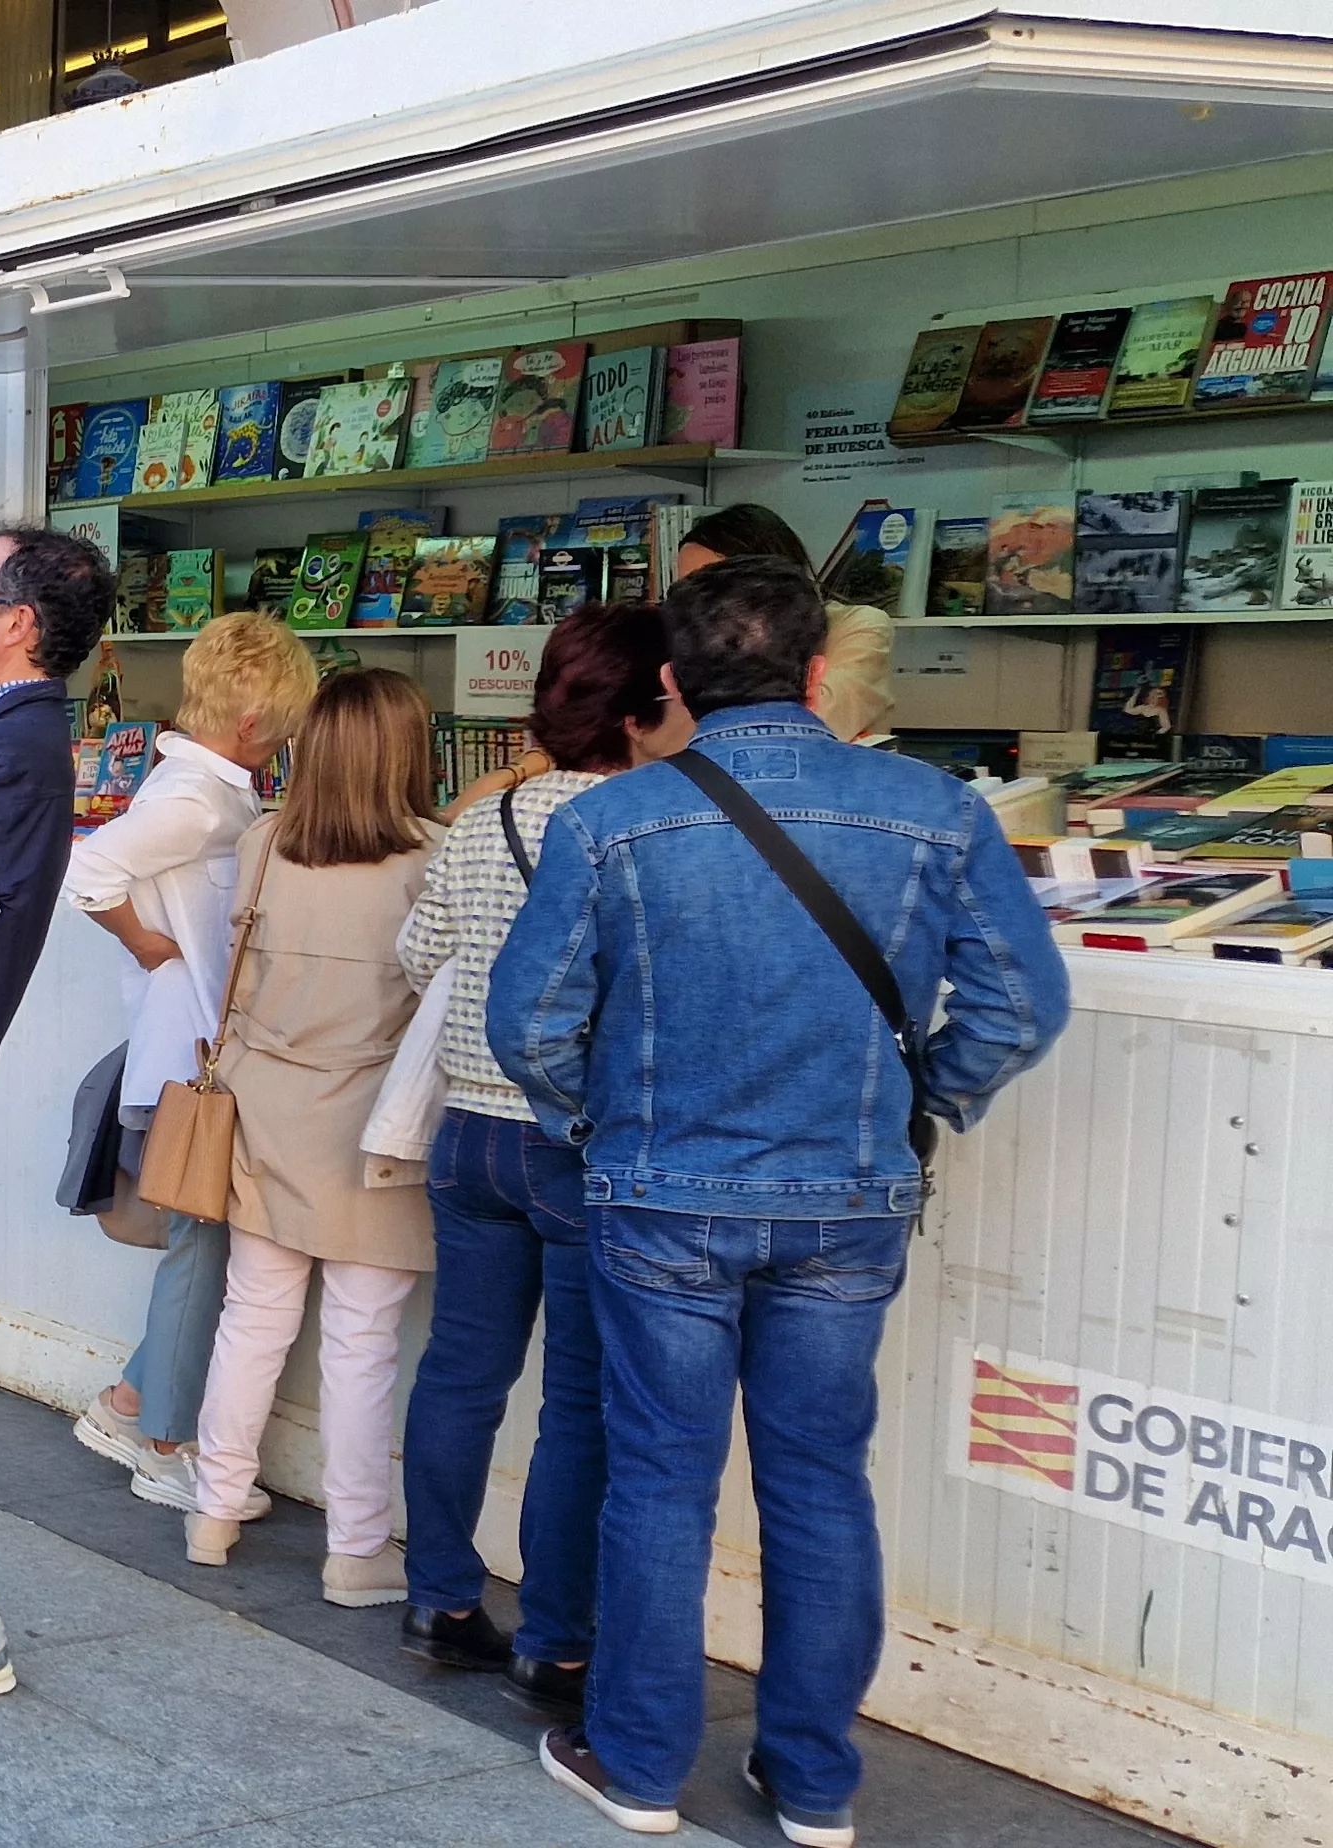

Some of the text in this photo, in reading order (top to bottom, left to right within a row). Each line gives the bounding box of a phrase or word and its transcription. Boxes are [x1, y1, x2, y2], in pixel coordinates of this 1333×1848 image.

[1253, 277, 1326, 311] COCINA
[1284, 305, 1320, 345] 10
[585, 361, 629, 401] TODO
[805, 426, 849, 439] FERIA
[852, 422, 883, 435] DEL
[805, 439, 885, 455] DE HUESCA
[1299, 498, 1312, 513] NI
[485, 649, 530, 672] 10%
[469, 678, 536, 690] DESCUENT
[106, 726, 146, 750] ARTA
[1087, 1393, 1333, 1499] GOBIER
[1085, 1450, 1167, 1517] DE
[1184, 1481, 1333, 1564] ARA
